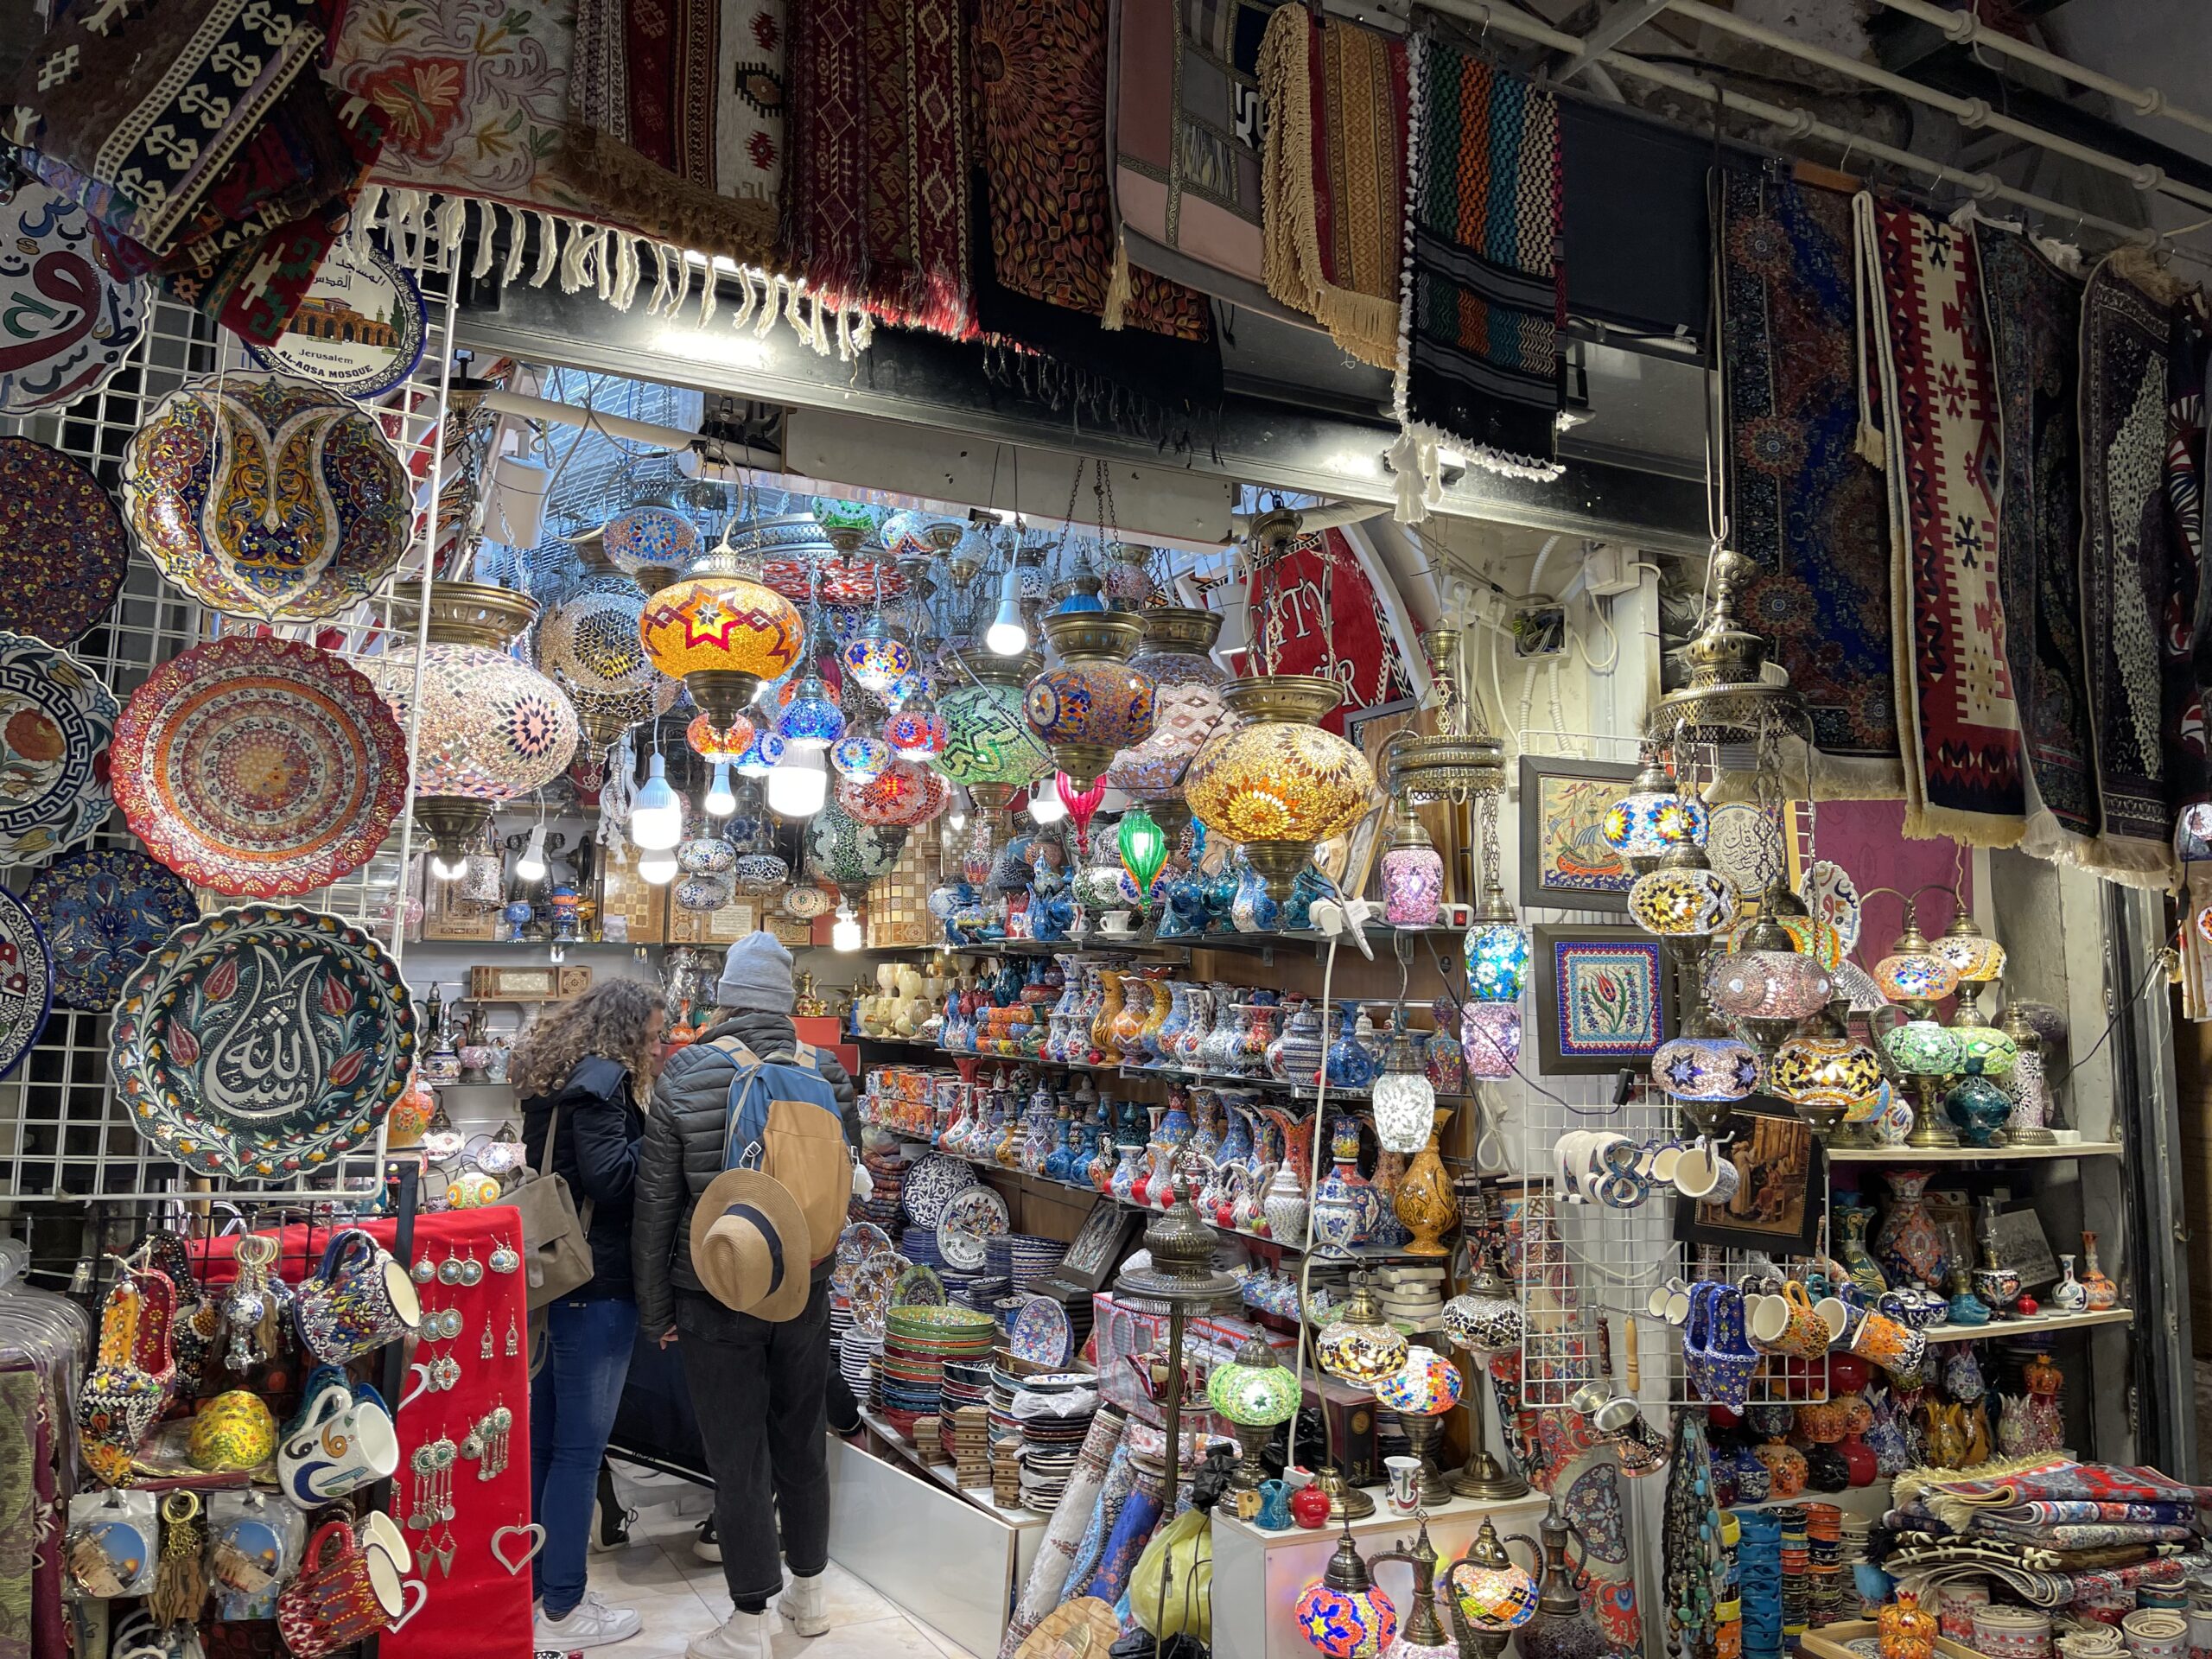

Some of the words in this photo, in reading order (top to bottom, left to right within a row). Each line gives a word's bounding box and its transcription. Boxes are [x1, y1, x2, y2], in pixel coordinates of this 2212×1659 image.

[278, 350, 325, 377] AL-AQSA
[328, 365, 373, 378] MOSQUE
[298, 348, 353, 365] Jerusalem
